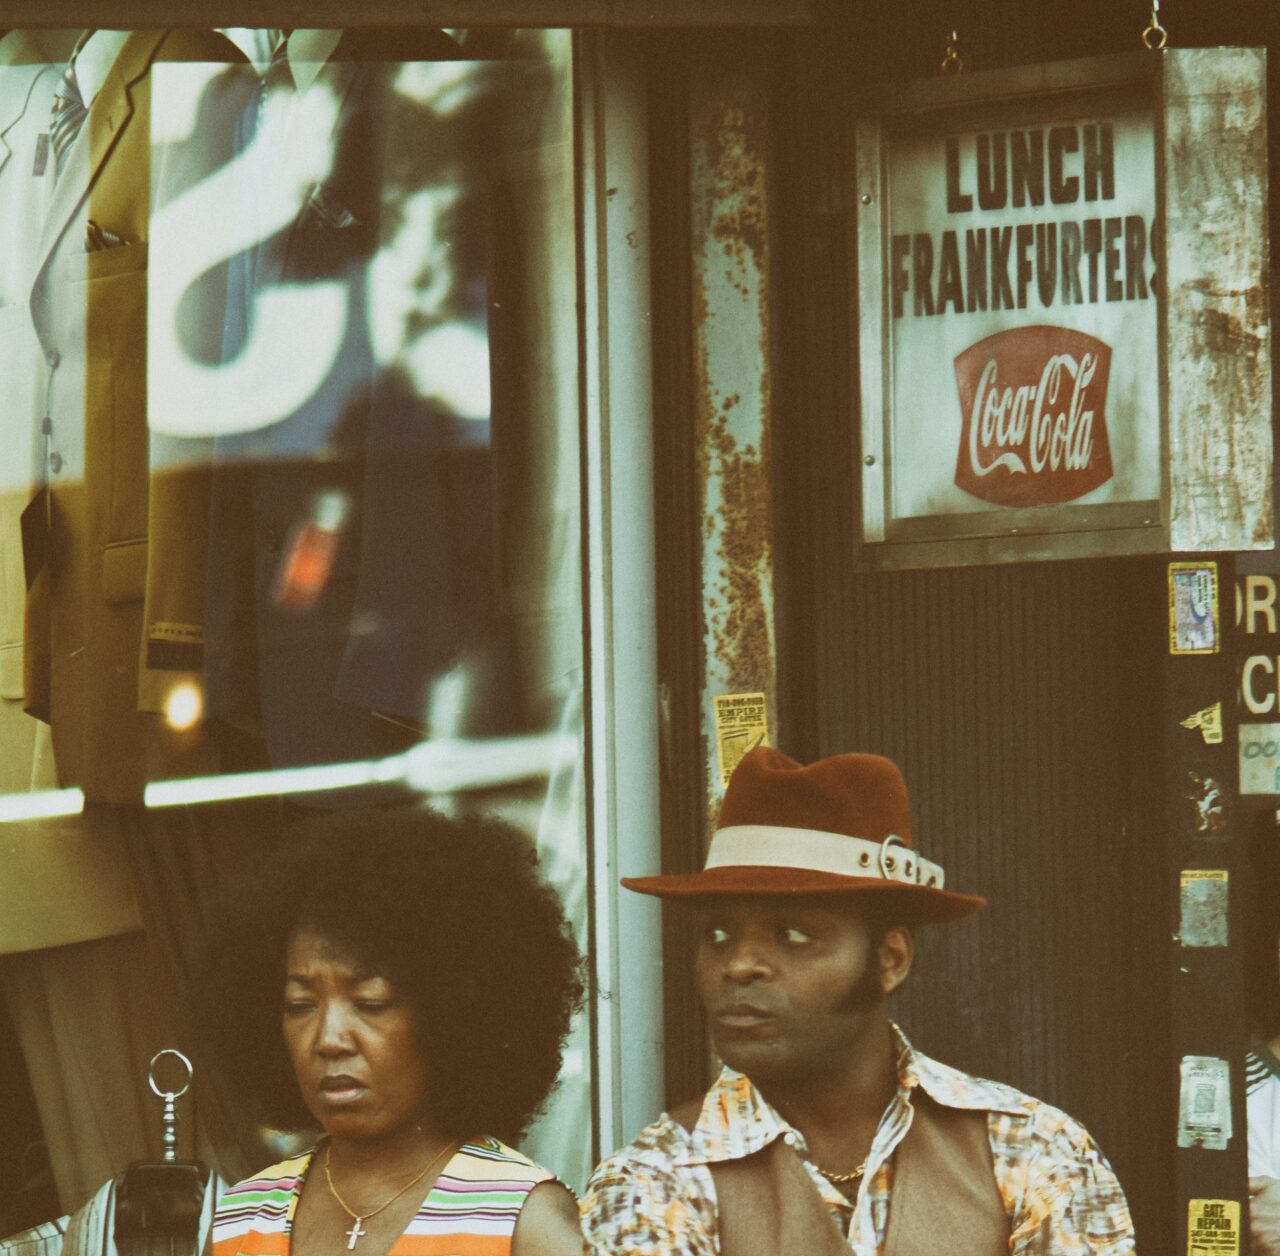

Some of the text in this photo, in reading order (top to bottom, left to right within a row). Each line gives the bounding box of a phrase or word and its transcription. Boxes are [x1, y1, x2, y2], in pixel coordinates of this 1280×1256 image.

[945, 122, 1116, 214] LUNCH
[718, 706, 764, 718] EMPIRE
[1203, 1203, 1224, 1218] GATE
[1197, 1218, 1231, 1230] REPAIR
